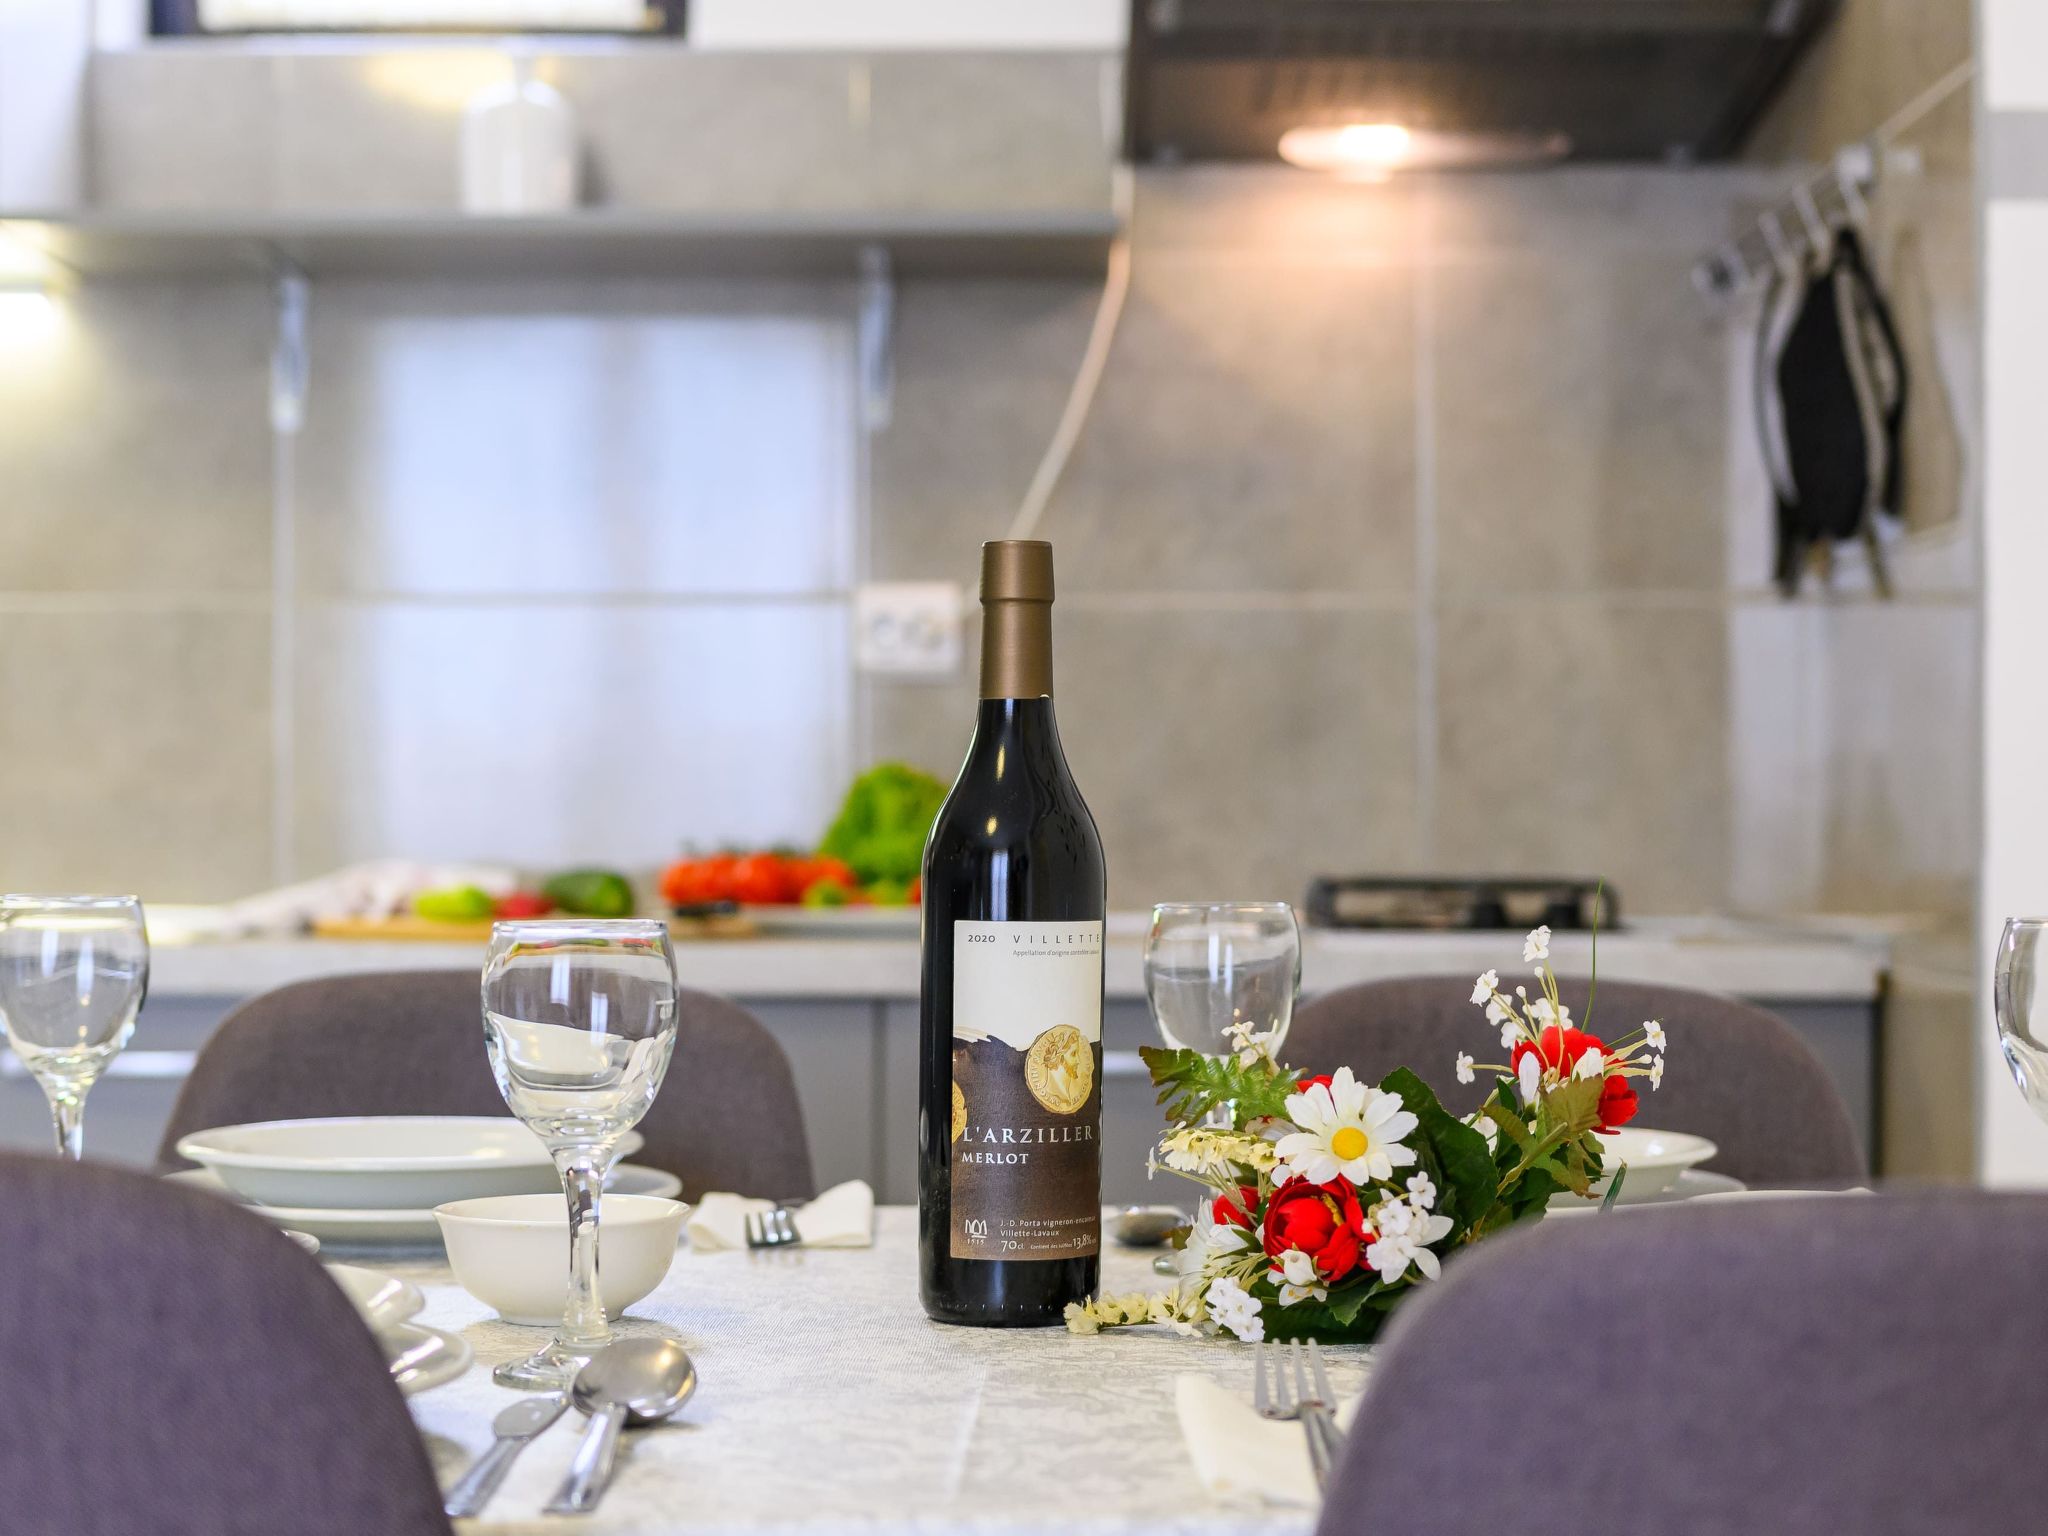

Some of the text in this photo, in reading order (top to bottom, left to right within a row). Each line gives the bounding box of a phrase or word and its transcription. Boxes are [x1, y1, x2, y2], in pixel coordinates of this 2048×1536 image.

[967, 934, 1100, 944] 2020 VILLETTE
[1013, 949, 1046, 957] Appellation
[963, 1125, 1093, 1144] L'ARZILLER
[961, 1152, 1029, 1164] MERLOT
[1019, 1218, 1041, 1227] Porta
[1000, 1229, 1060, 1237] Villette-Lavaux
